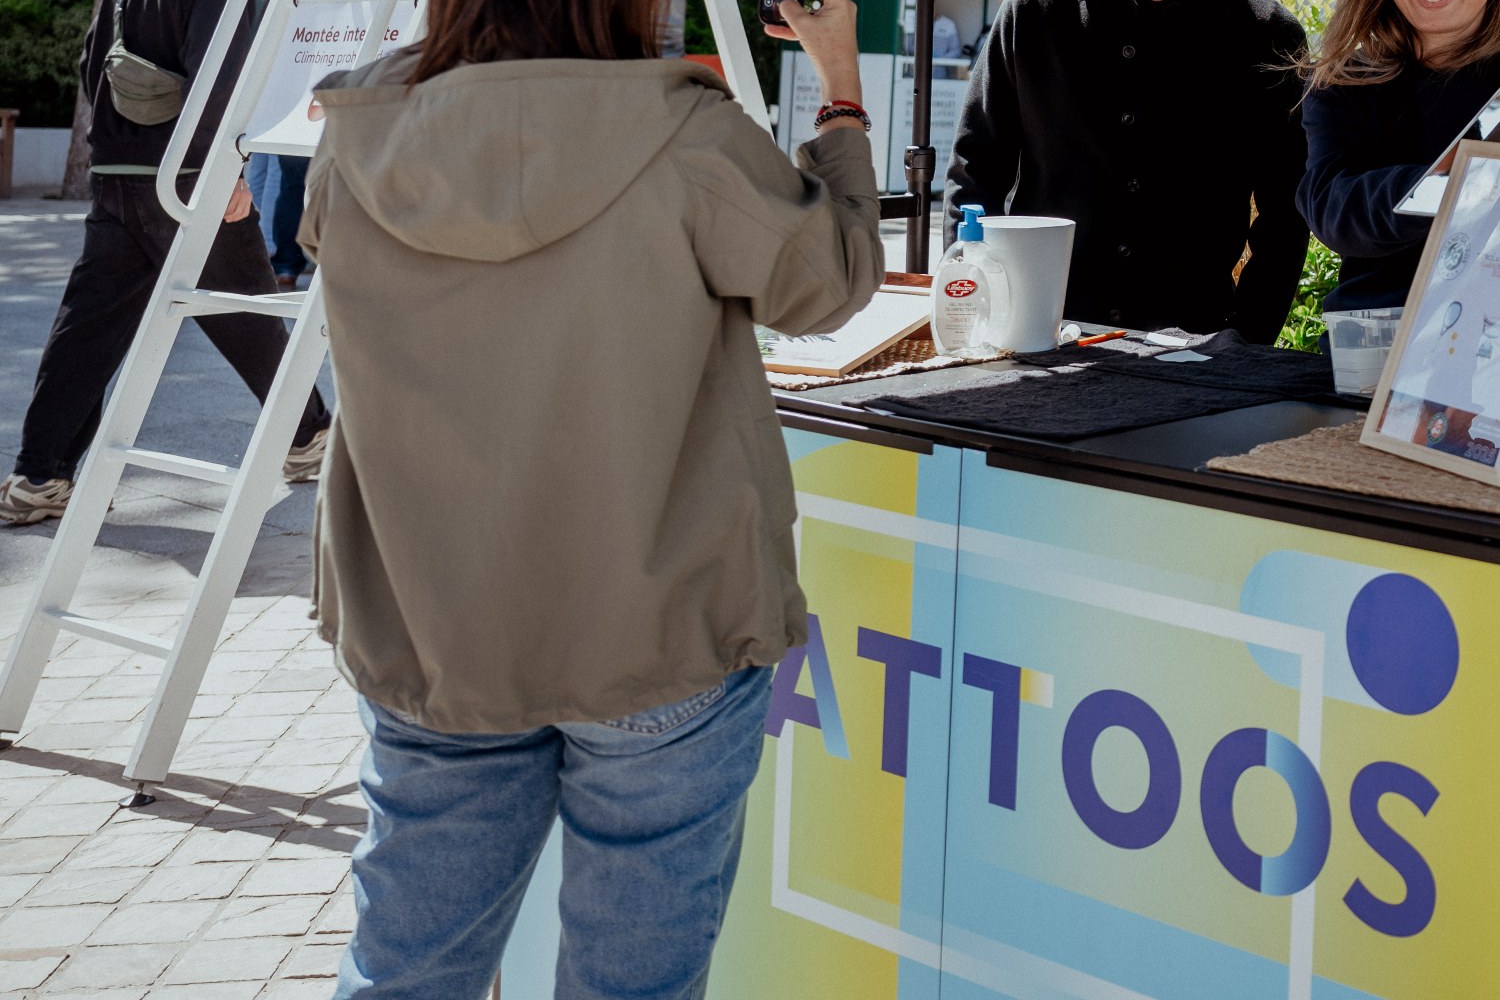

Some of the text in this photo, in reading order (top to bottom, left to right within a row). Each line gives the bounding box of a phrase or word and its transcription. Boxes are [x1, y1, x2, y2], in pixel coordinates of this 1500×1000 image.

[292, 25, 399, 43] Montée intete
[294, 51, 334, 66] Climbing
[763, 611, 1441, 939] ATTOOS
